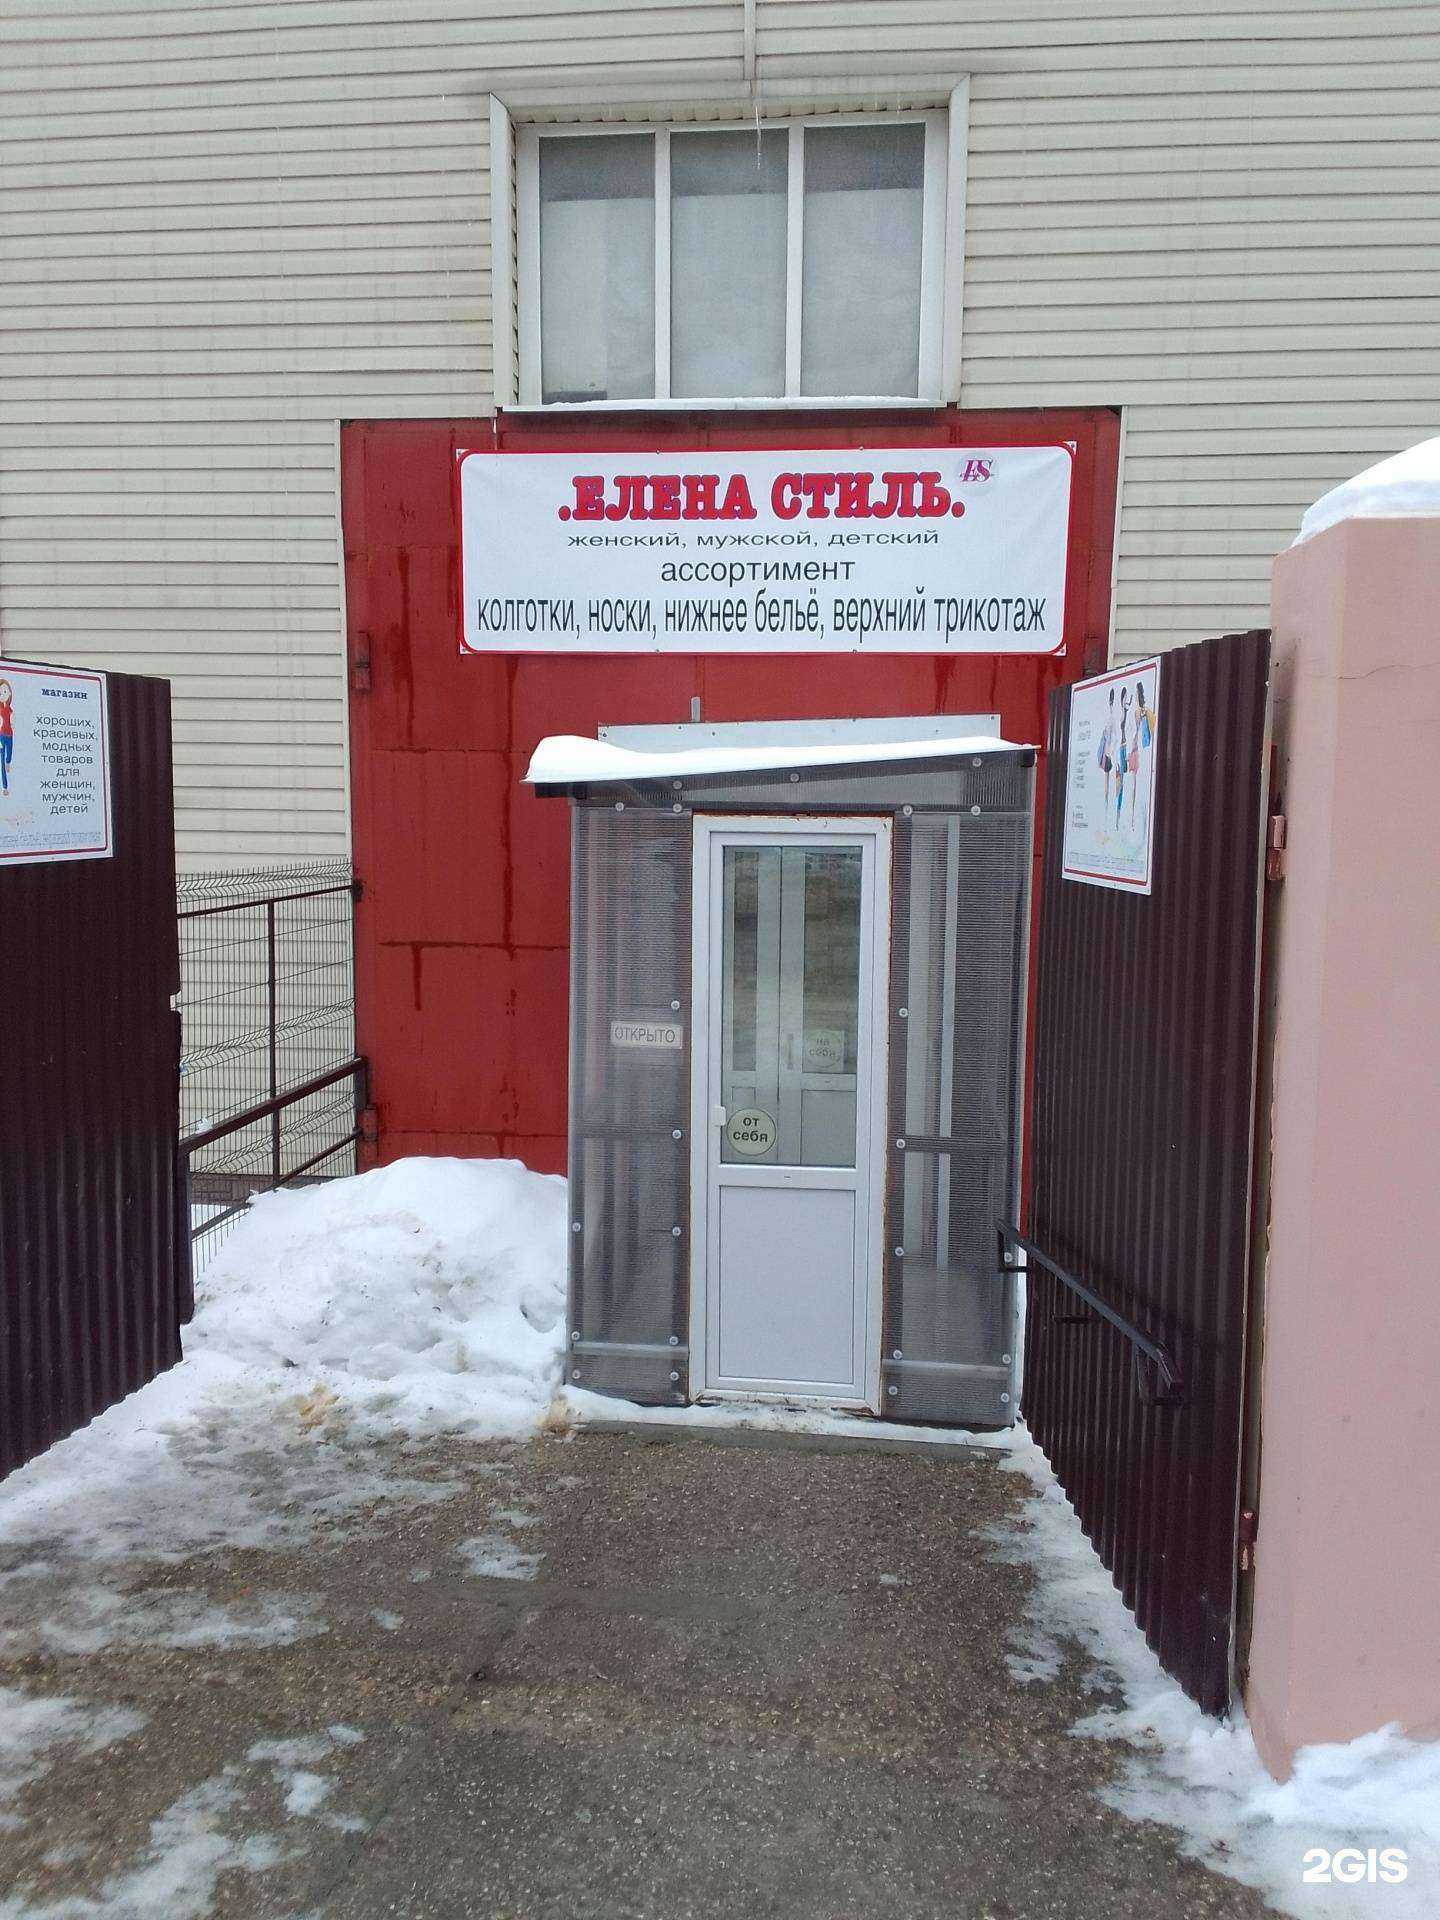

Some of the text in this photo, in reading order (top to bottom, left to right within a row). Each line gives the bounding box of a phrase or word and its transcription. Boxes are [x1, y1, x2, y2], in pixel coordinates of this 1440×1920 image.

[568, 529, 938, 549] женский, мужской, детский
[661, 561, 855, 588] ассортимент
[478, 586, 1046, 643] колготки, носки, нижнее бельё, верхний трикотаж
[42, 687, 88, 700] магазин
[36, 714, 95, 728] хороших,
[33, 728, 98, 741] красивых,
[42, 742, 91, 753] модных
[42, 755, 93, 766] товаров
[56, 768, 80, 778] для
[40, 781, 96, 792] женщин,
[42, 793, 95, 804] мужчин,
[50, 804, 89, 816] детей
[614, 1028, 676, 1043] ОТКРЫТО
[743, 1117, 759, 1127] от
[733, 1130, 768, 1143] себя
